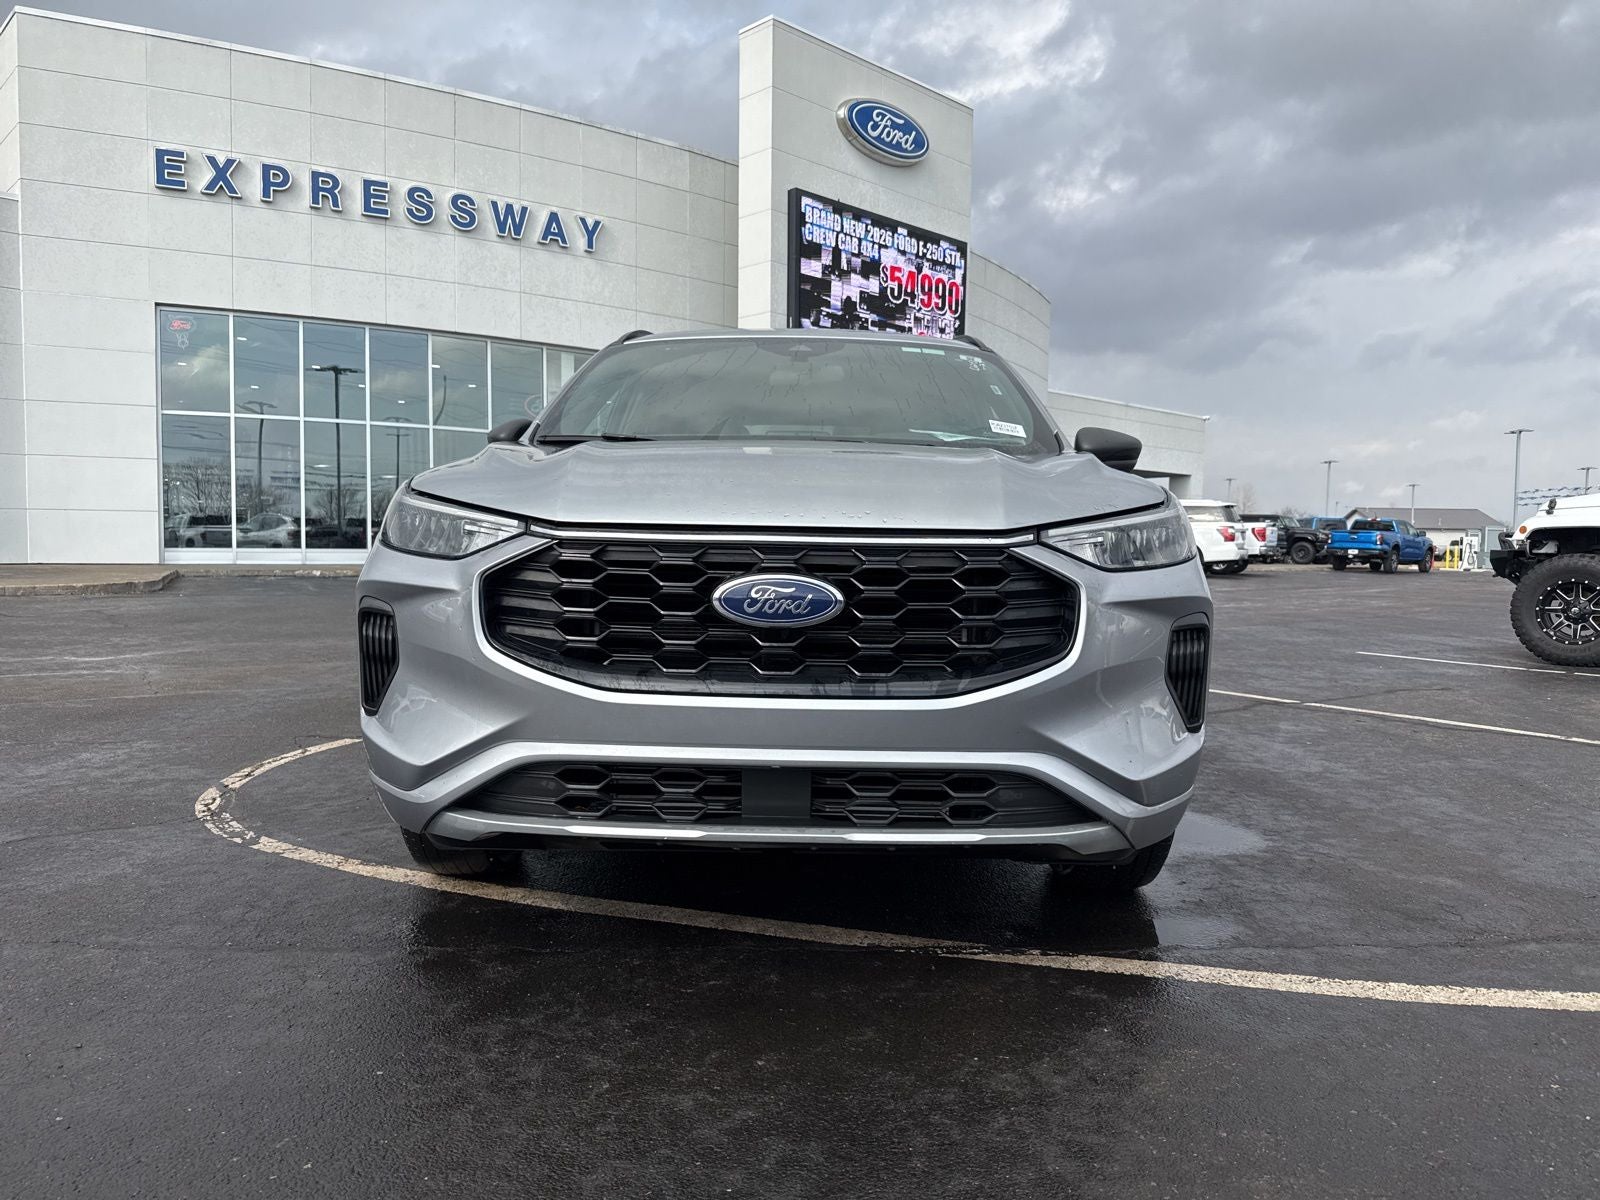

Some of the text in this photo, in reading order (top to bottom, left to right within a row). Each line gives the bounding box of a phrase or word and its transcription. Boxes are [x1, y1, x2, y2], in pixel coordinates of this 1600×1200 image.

[867, 109, 916, 151] Ford
[153, 146, 604, 253] EXPRESSWAY
[804, 205, 842, 232] BRAND
[842, 216, 866, 239] NEW
[894, 232, 918, 255] FORD
[918, 240, 944, 262] F-250
[804, 223, 837, 248] CREW
[837, 233, 859, 254] CAB
[743, 585, 813, 614] Ford
